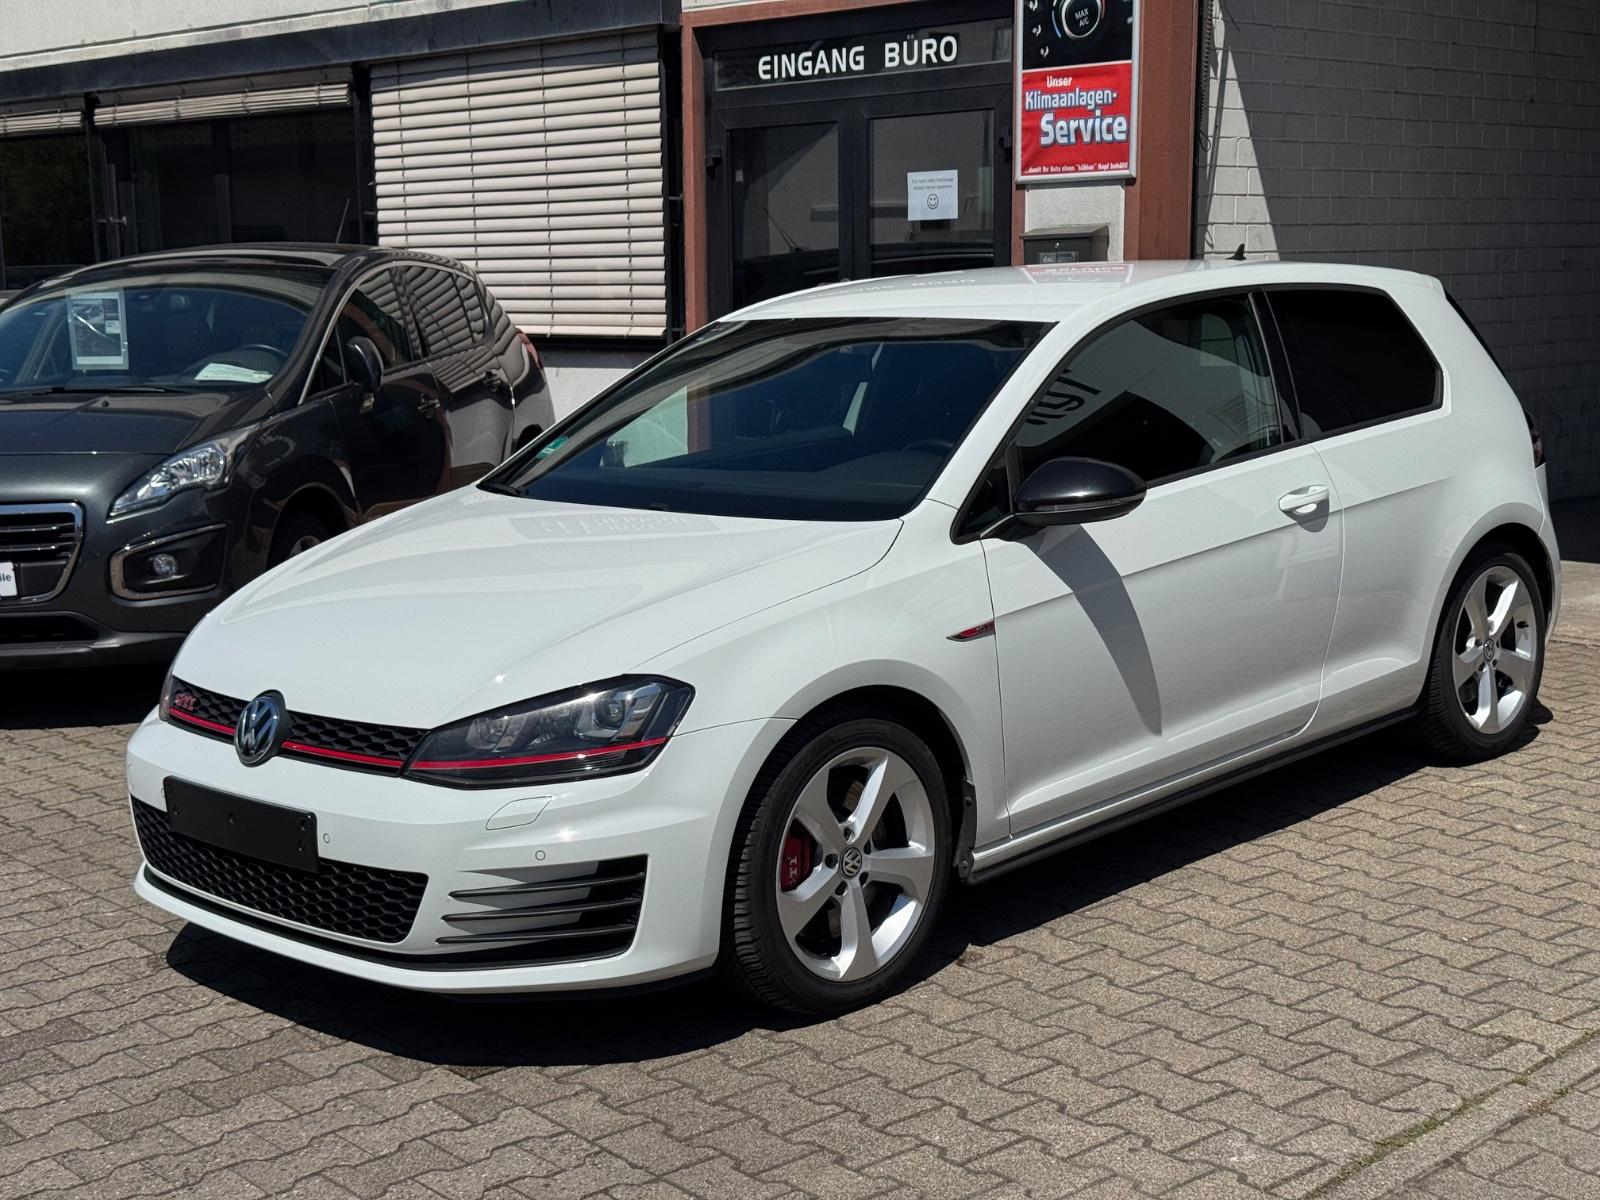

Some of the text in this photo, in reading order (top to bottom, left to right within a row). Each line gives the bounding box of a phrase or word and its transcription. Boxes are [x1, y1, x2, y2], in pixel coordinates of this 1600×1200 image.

[1075, 8, 1089, 20] MAX
[758, 34, 958, 80] EINGANG BÜRO
[1046, 76, 1073, 88] Unser
[1025, 88, 1118, 110] Klimaanlagen-
[1040, 110, 1127, 146] Service
